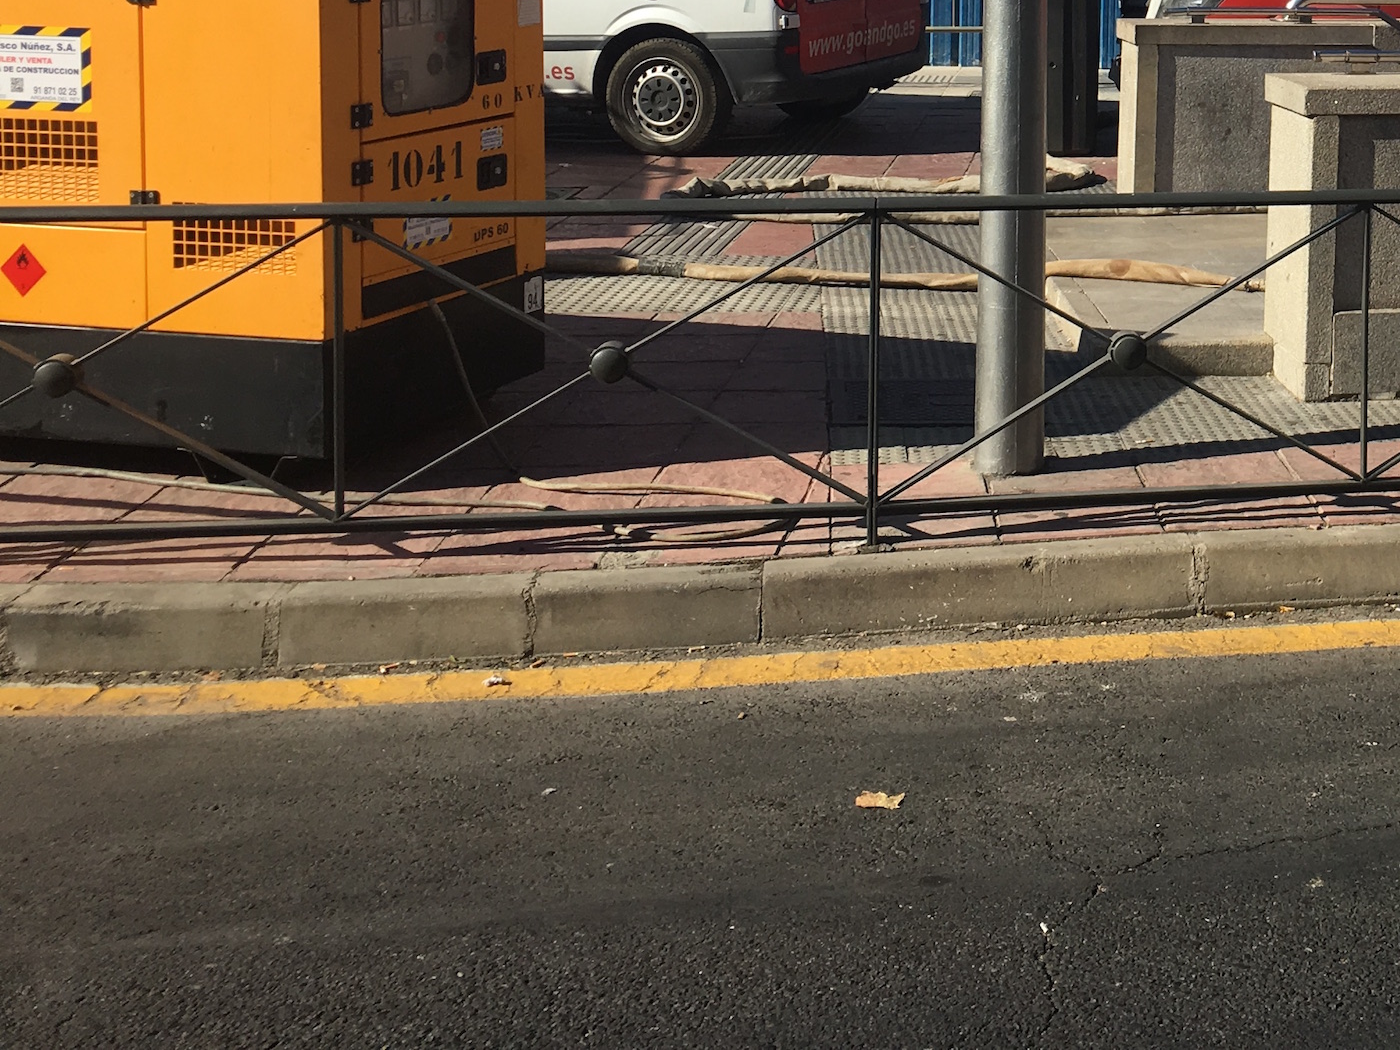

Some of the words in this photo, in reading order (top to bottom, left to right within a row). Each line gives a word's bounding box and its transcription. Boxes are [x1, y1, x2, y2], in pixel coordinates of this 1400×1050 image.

[808, 20, 916, 57] www.goandgo.es
[20, 41, 53, 53] Núñez,
[57, 43, 76, 52] S.A.
[16, 66, 79, 75] CONSTRUCCION
[33, 86, 41, 94] 91
[44, 86, 56, 95] 871
[58, 87, 66, 95] 02
[69, 88, 77, 96] 25
[482, 93, 502, 109] 60
[388, 141, 464, 191] 1041
[497, 222, 509, 235] 60
